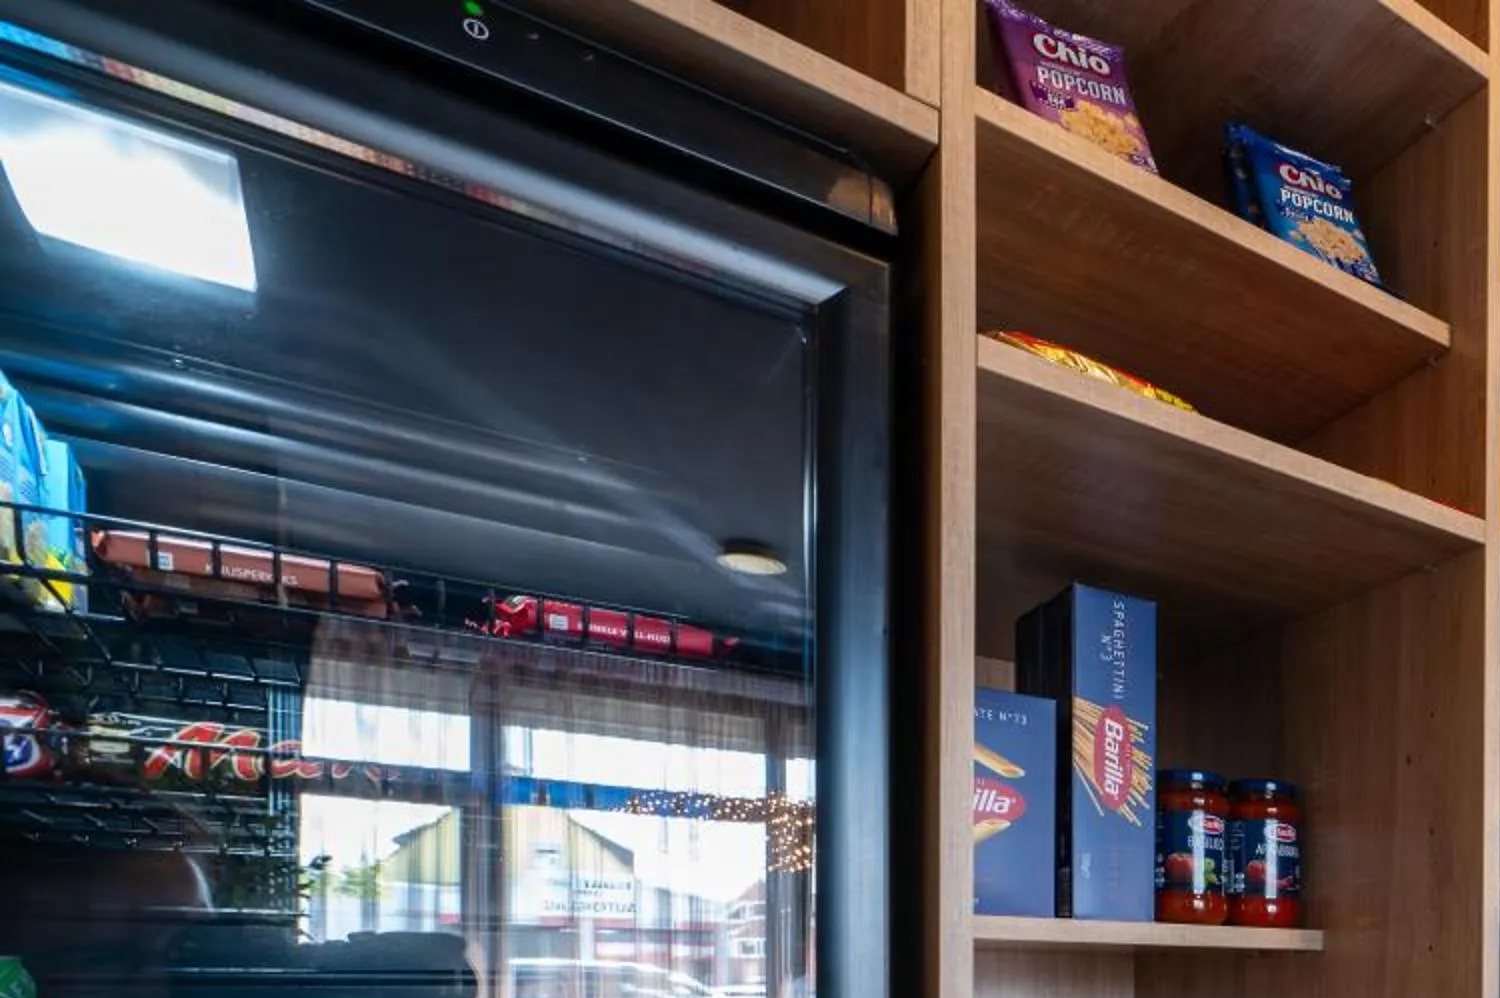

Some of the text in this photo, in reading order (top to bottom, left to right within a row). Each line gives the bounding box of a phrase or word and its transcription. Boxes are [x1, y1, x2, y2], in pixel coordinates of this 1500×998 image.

[1033, 33, 1111, 76] Chio
[1036, 66, 1127, 105] POPCORN
[1279, 163, 1343, 200] Chio
[1280, 188, 1355, 225] POPCORN
[1112, 600, 1127, 700] SPAGHETTINI
[1104, 718, 1124, 796] Barilla
